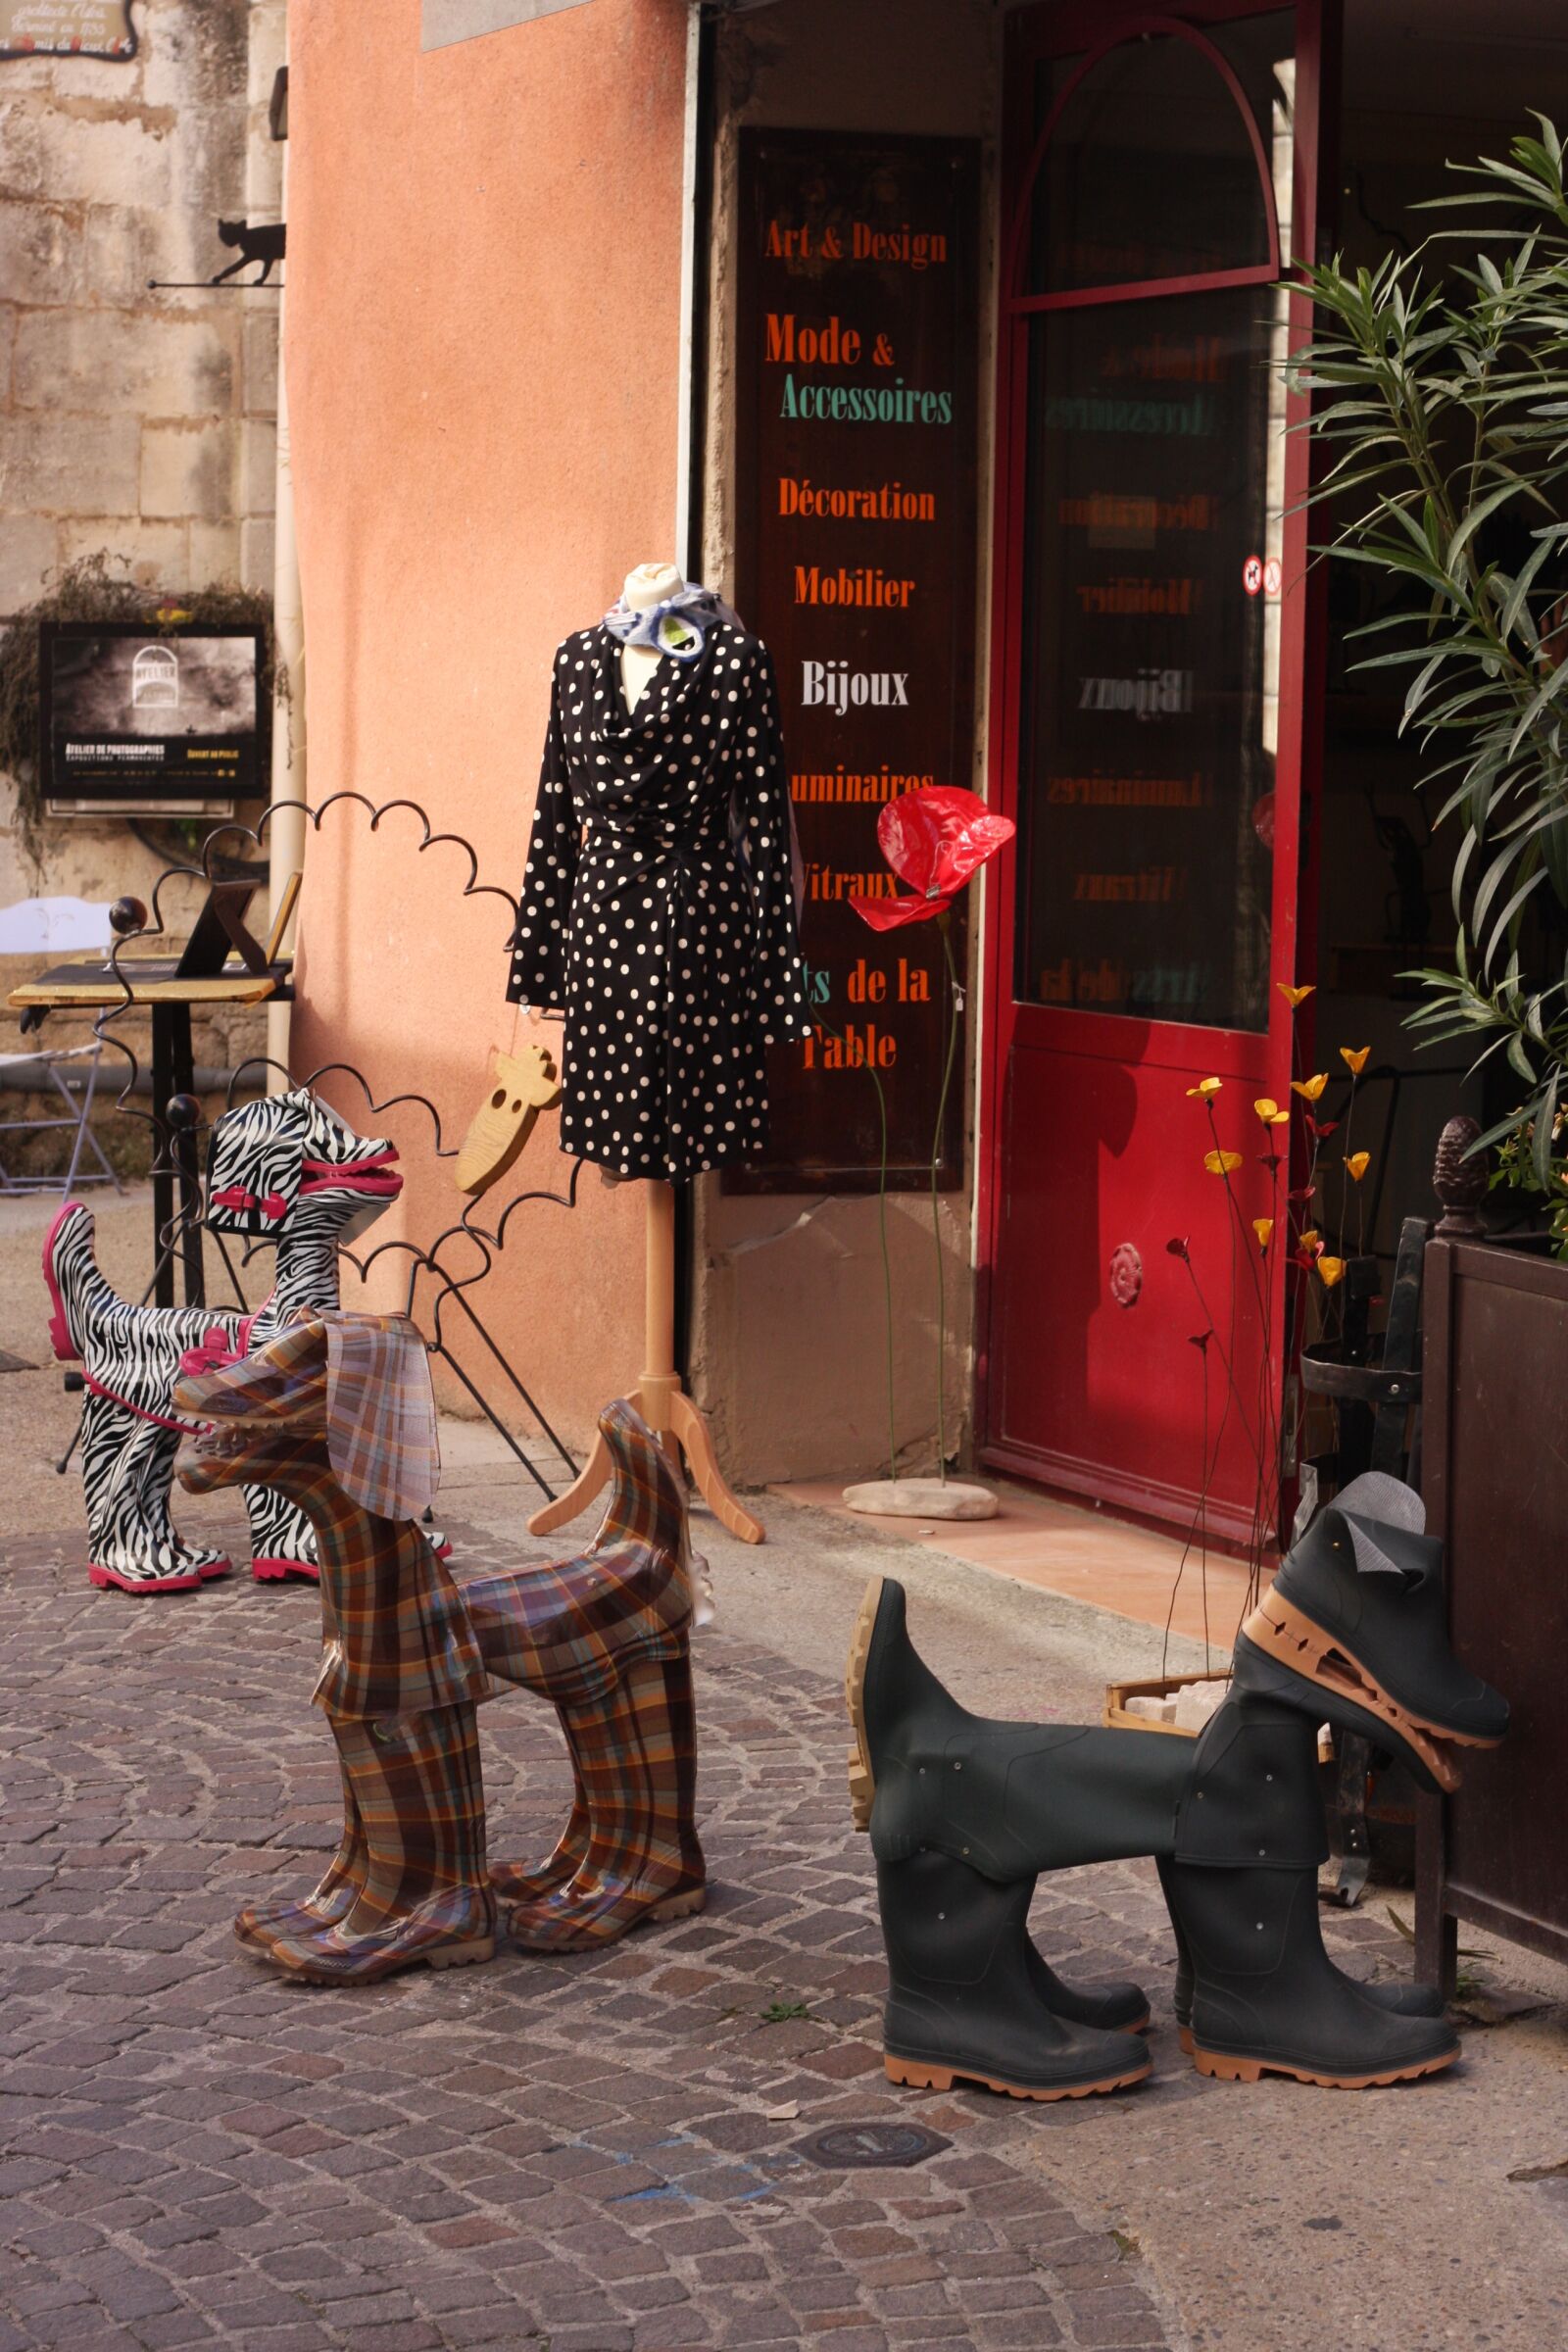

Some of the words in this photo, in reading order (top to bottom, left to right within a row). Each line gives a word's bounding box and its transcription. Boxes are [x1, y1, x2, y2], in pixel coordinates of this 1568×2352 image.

[765, 220, 811, 258] Art
[821, 226, 844, 259] &
[853, 221, 948, 270] Design
[765, 314, 861, 365] Mode
[873, 334, 895, 366] &
[779, 373, 953, 424] Accessoires
[778, 477, 936, 520] Décoration
[794, 565, 915, 608] Mobilier
[801, 661, 909, 715] Bijoux
[848, 957, 887, 1004] de
[897, 957, 932, 1004] la
[802, 1023, 898, 1070] Table
